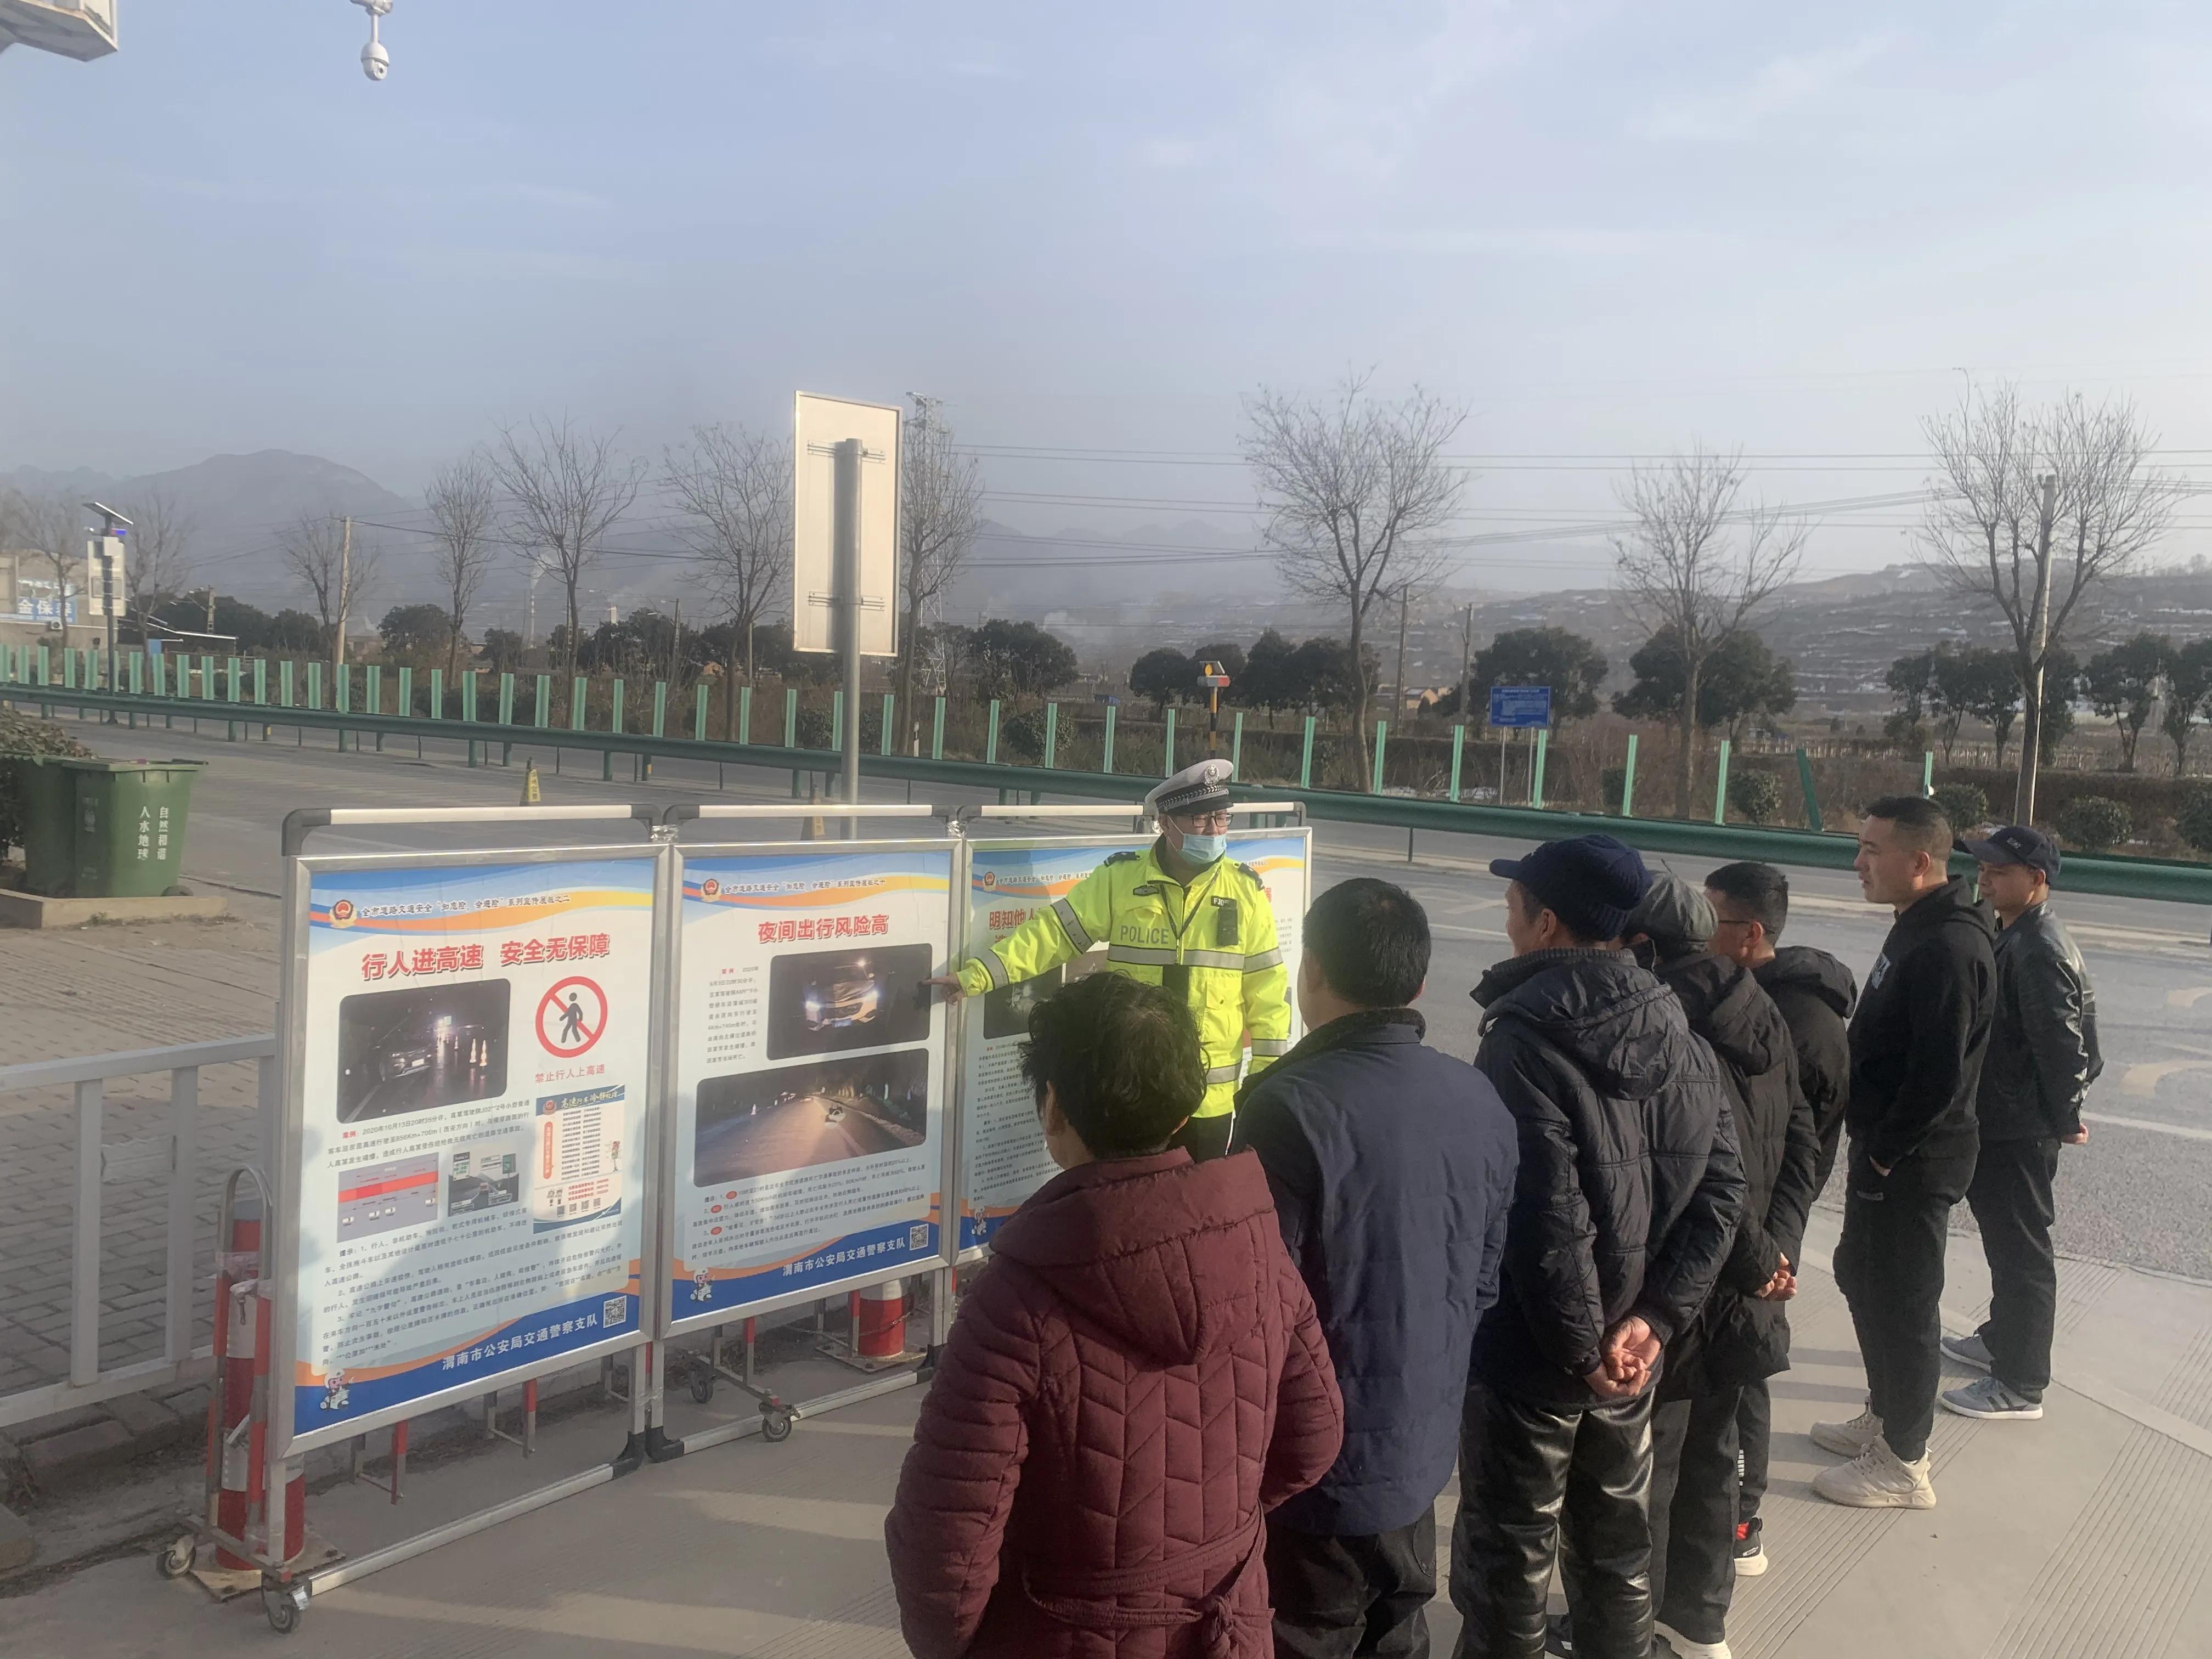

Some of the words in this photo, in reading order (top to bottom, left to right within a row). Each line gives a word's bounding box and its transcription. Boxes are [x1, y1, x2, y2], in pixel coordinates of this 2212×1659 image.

[758, 914, 890, 944] 夜间出行风险高
[1120, 925, 1169, 944] POLICE
[361, 943, 483, 981] 行人进高速
[500, 933, 610, 966] 安全无保障
[535, 1064, 606, 1084] 禁止行人上高速
[783, 1237, 906, 1277] 渭南市公安局交通警察支队
[442, 1313, 598, 1371] 渭南市公安局交通警察支队
